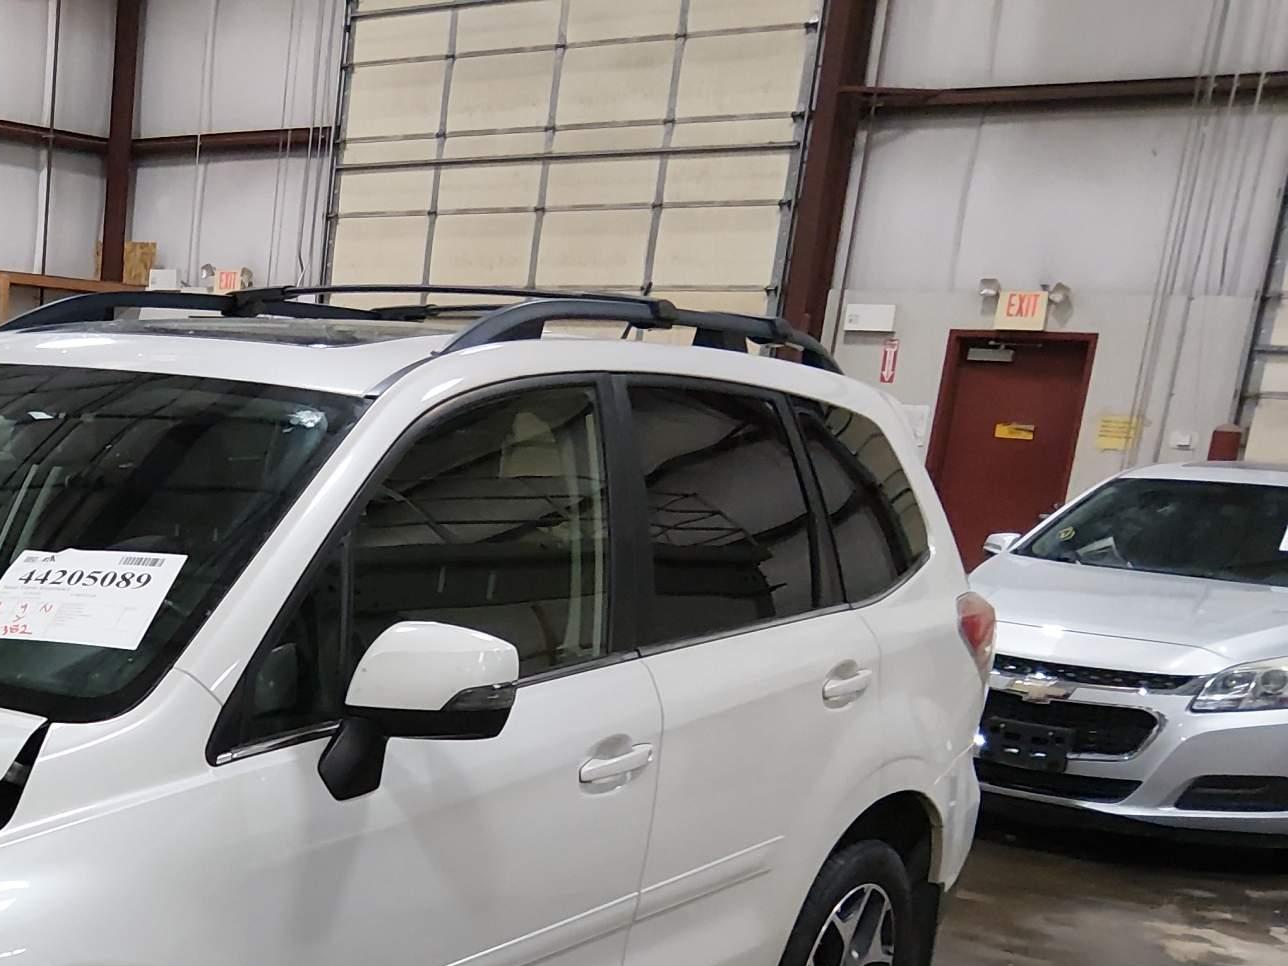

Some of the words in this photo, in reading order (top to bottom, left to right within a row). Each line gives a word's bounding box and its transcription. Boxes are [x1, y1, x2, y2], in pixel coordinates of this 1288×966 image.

[219, 271, 238, 290] EXIT
[1006, 293, 1041, 318] EXIT
[18, 569, 152, 590] 44205089
